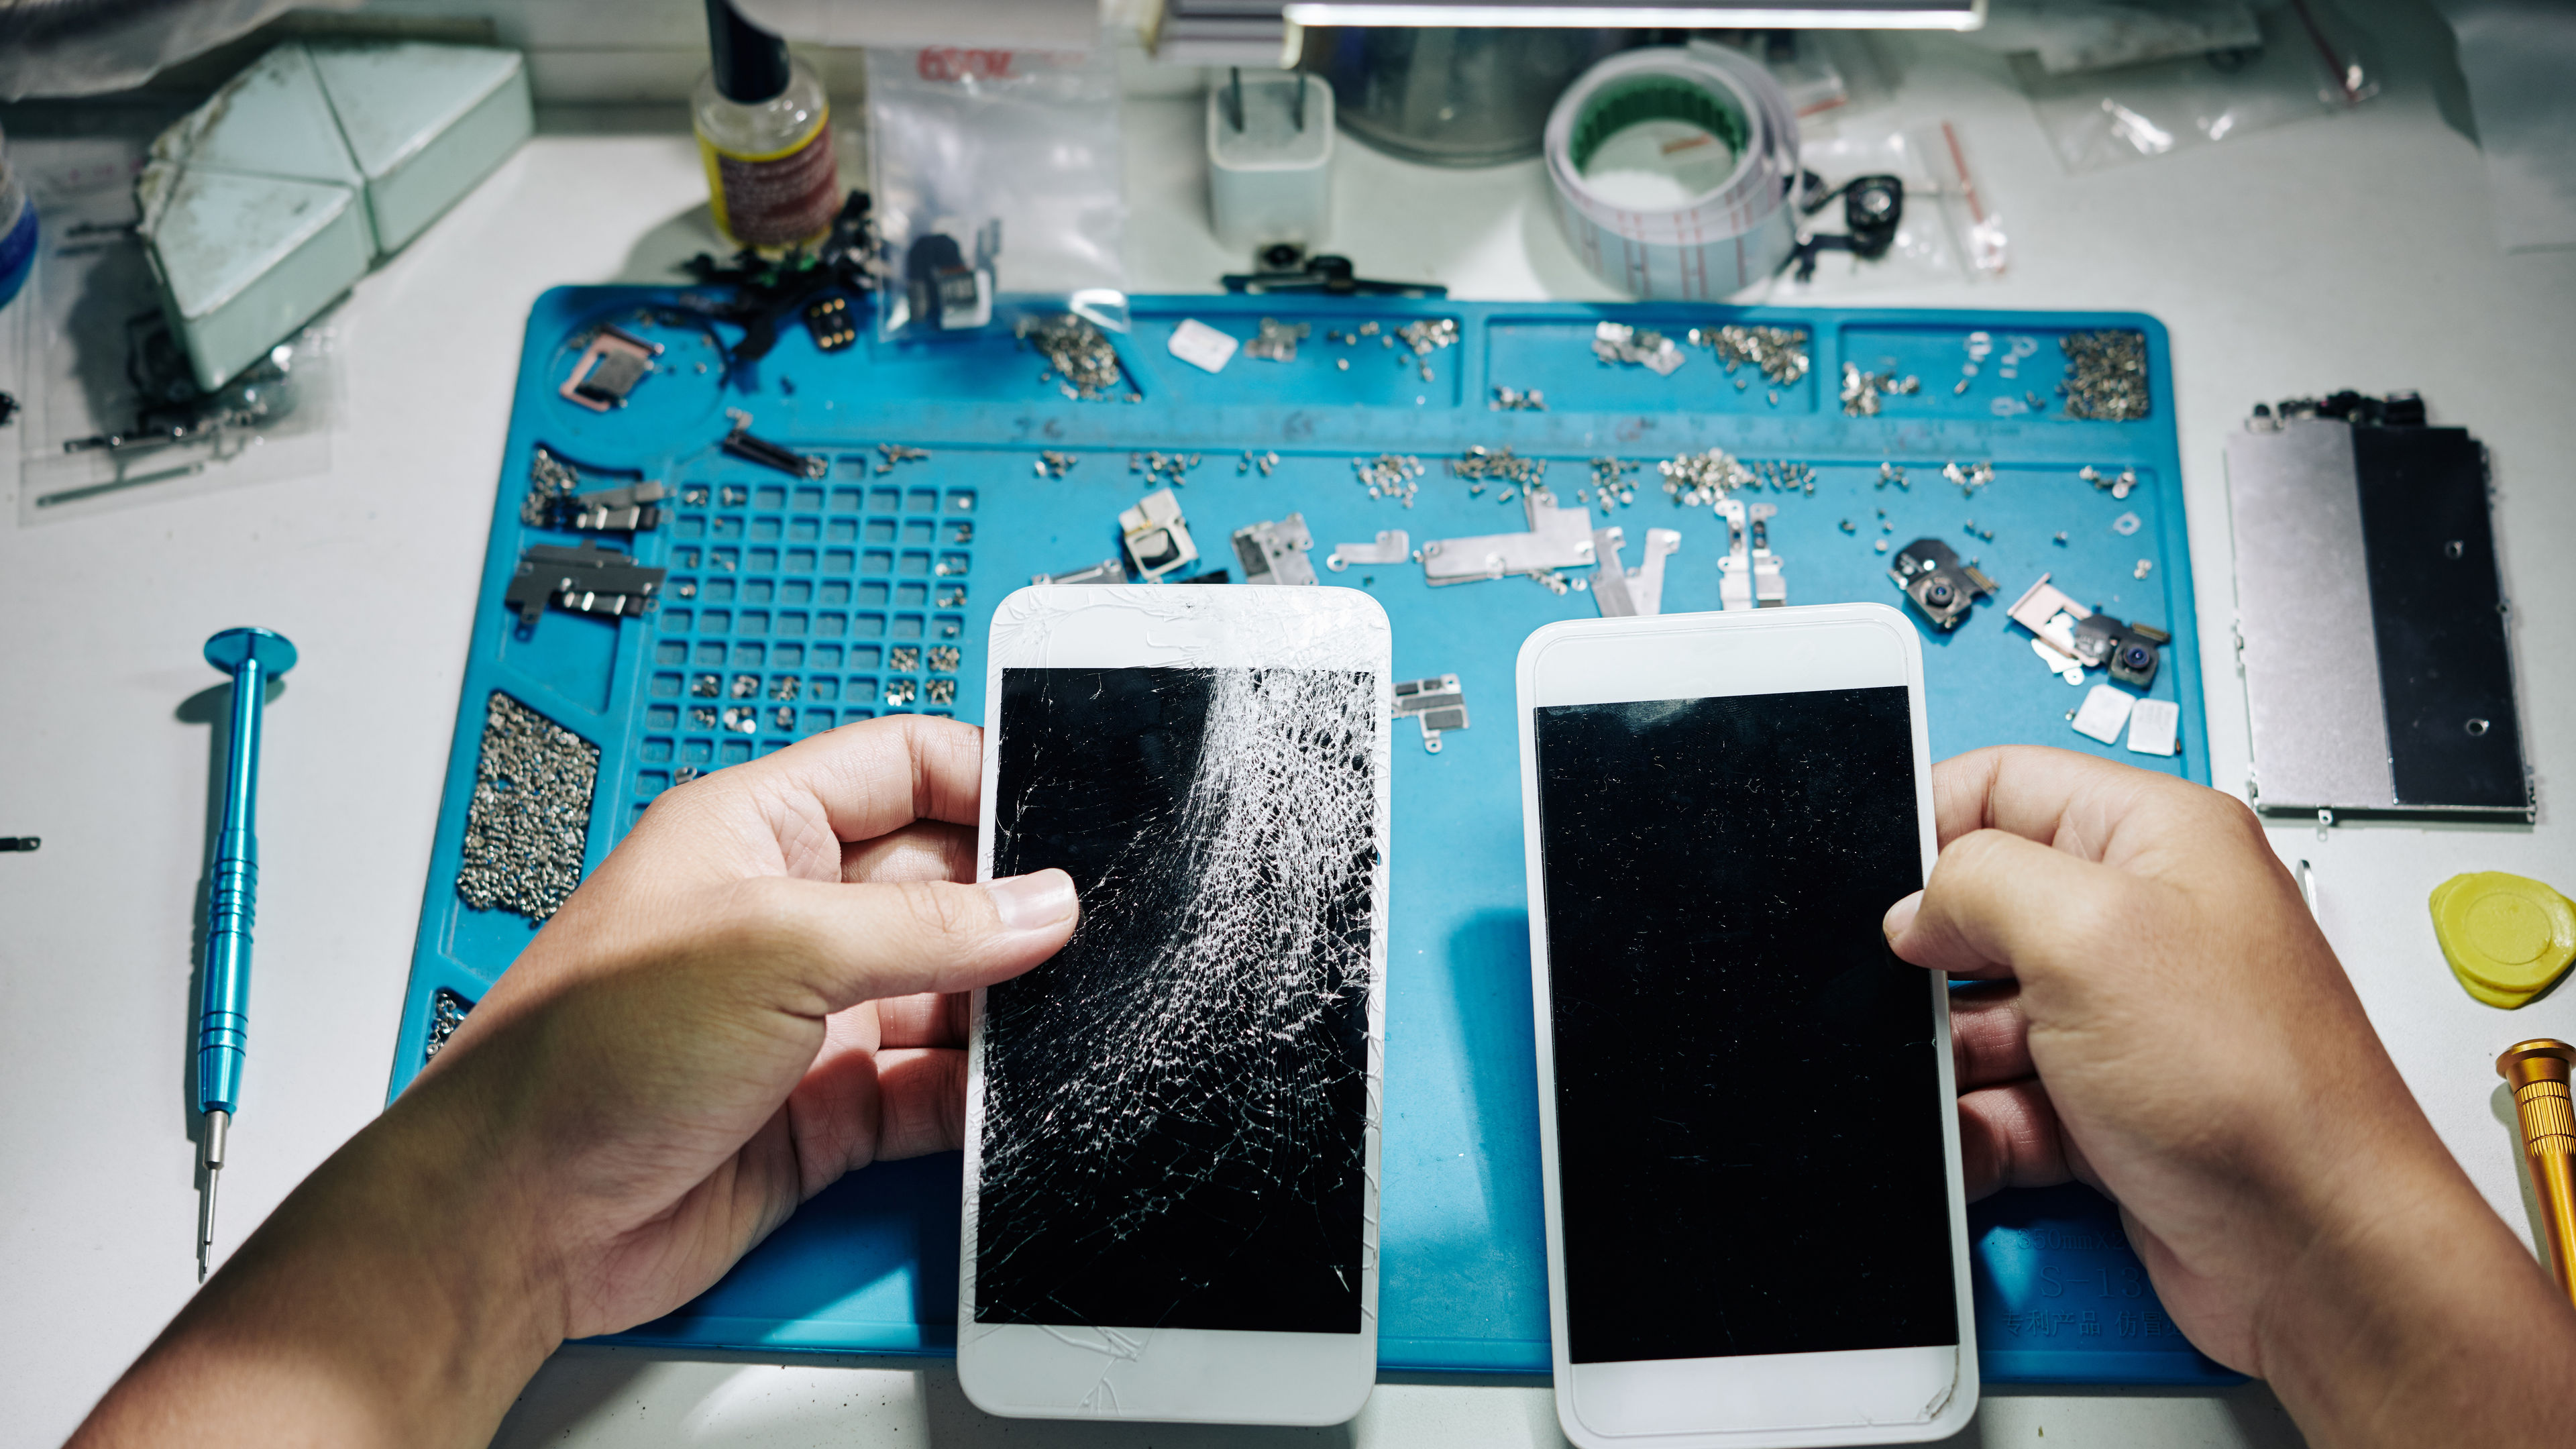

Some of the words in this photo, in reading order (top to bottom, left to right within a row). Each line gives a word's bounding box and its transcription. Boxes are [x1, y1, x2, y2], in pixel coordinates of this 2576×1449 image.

[2039, 1265, 2157, 1299] S-13
[2001, 1308, 2102, 1338] 专利产品
